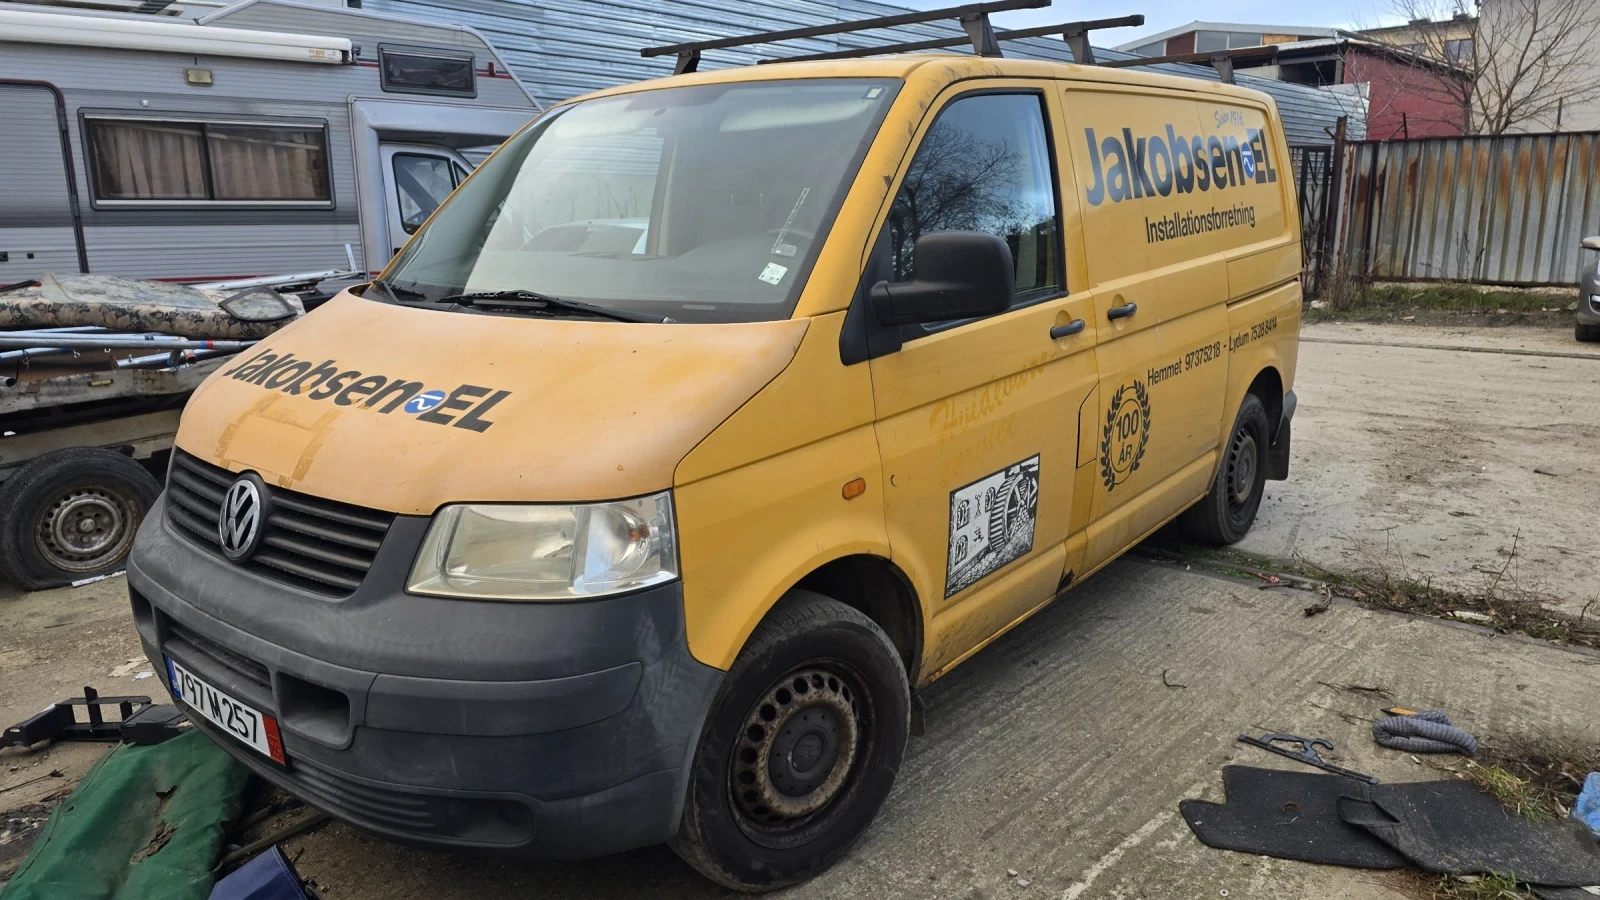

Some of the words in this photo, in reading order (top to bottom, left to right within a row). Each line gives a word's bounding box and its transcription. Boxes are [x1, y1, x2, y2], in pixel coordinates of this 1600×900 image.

[1085, 124, 1244, 206] Jakobsen
[1145, 203, 1256, 244] Installationsforretning
[224, 348, 423, 414] Jakobsen
[1147, 360, 1182, 387] Hemmet
[1229, 332, 1250, 353] Lydum
[1116, 408, 1140, 442] 100
[1117, 440, 1133, 466] ÅR
[174, 667, 204, 710] 797
[222, 698, 258, 744] 257
